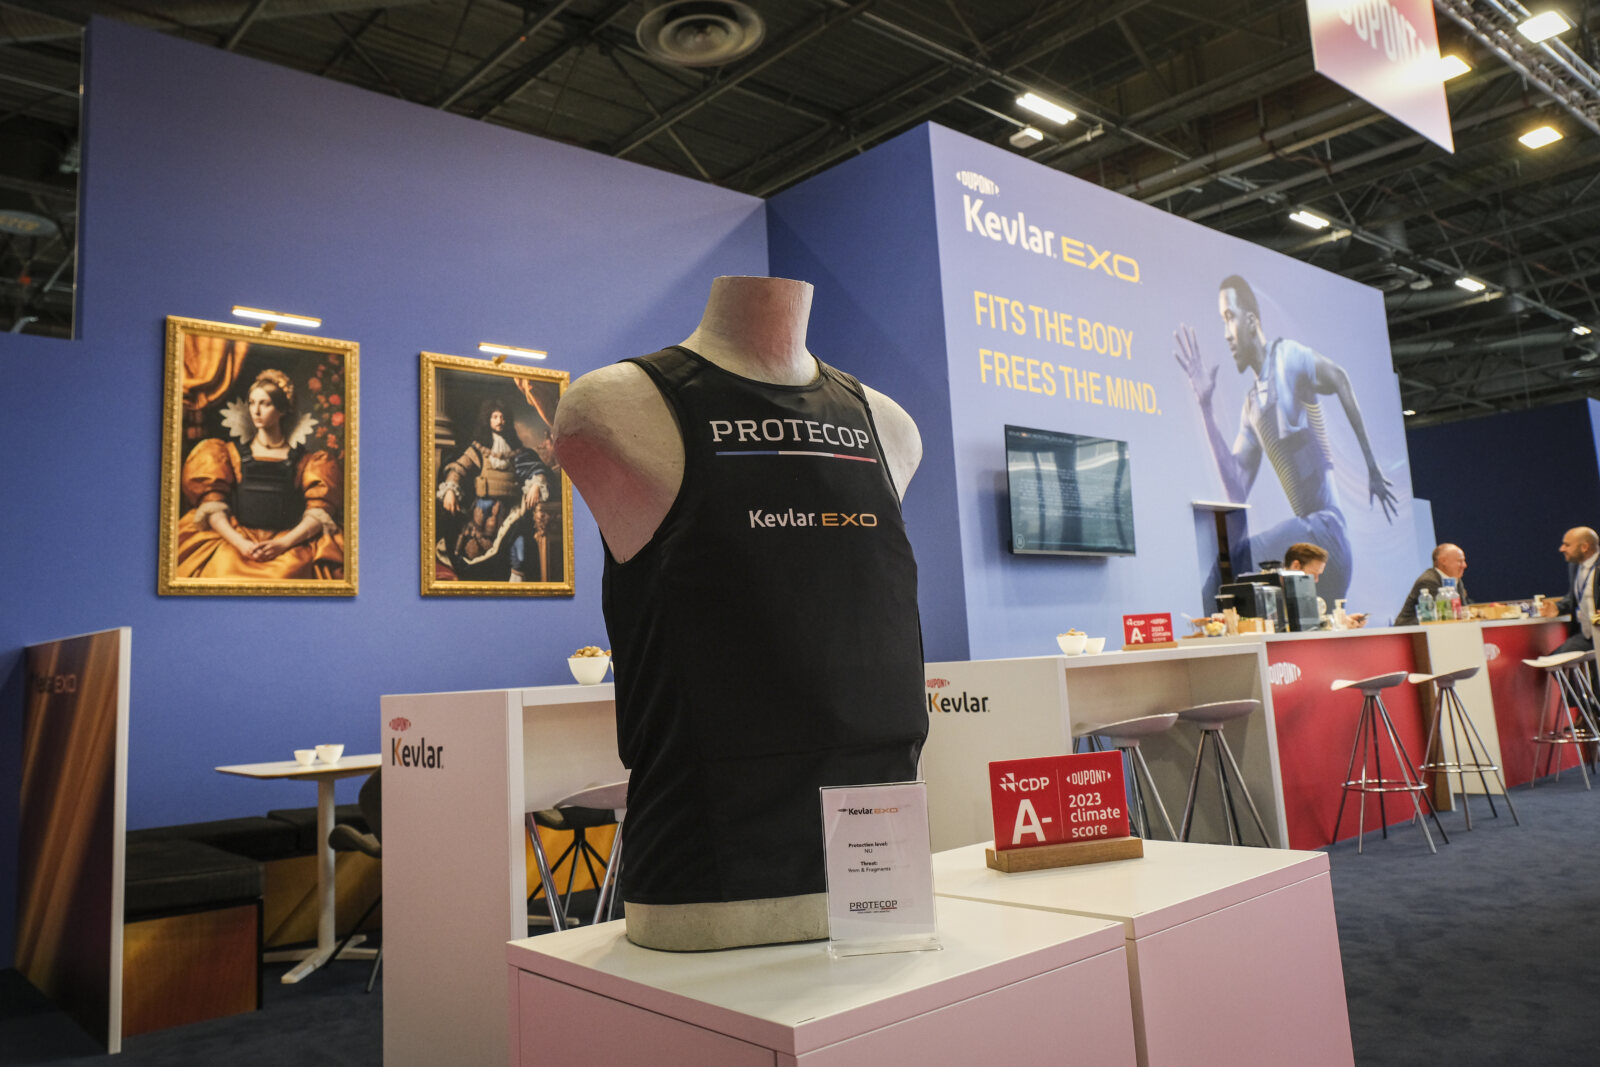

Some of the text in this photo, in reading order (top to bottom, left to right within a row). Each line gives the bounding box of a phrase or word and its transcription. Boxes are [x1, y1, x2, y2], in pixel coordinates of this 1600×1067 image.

[1339, 0, 1416, 62] UPONT
[1061, 236, 1140, 283] EXO
[973, 290, 1134, 360] FITS THE BODY
[978, 347, 1162, 415] FREES THE MIND.
[709, 418, 870, 449] PROTECOP
[821, 512, 878, 527] EXO
[1018, 769, 1107, 792] CDP DUPONT
[1068, 792, 1102, 808] 2023
[1011, 798, 1053, 845] A-
[1070, 807, 1121, 823] climate
[1072, 824, 1108, 838] score
[866, 866, 891, 874] Fragments
[849, 900, 898, 910] PROTECOP
